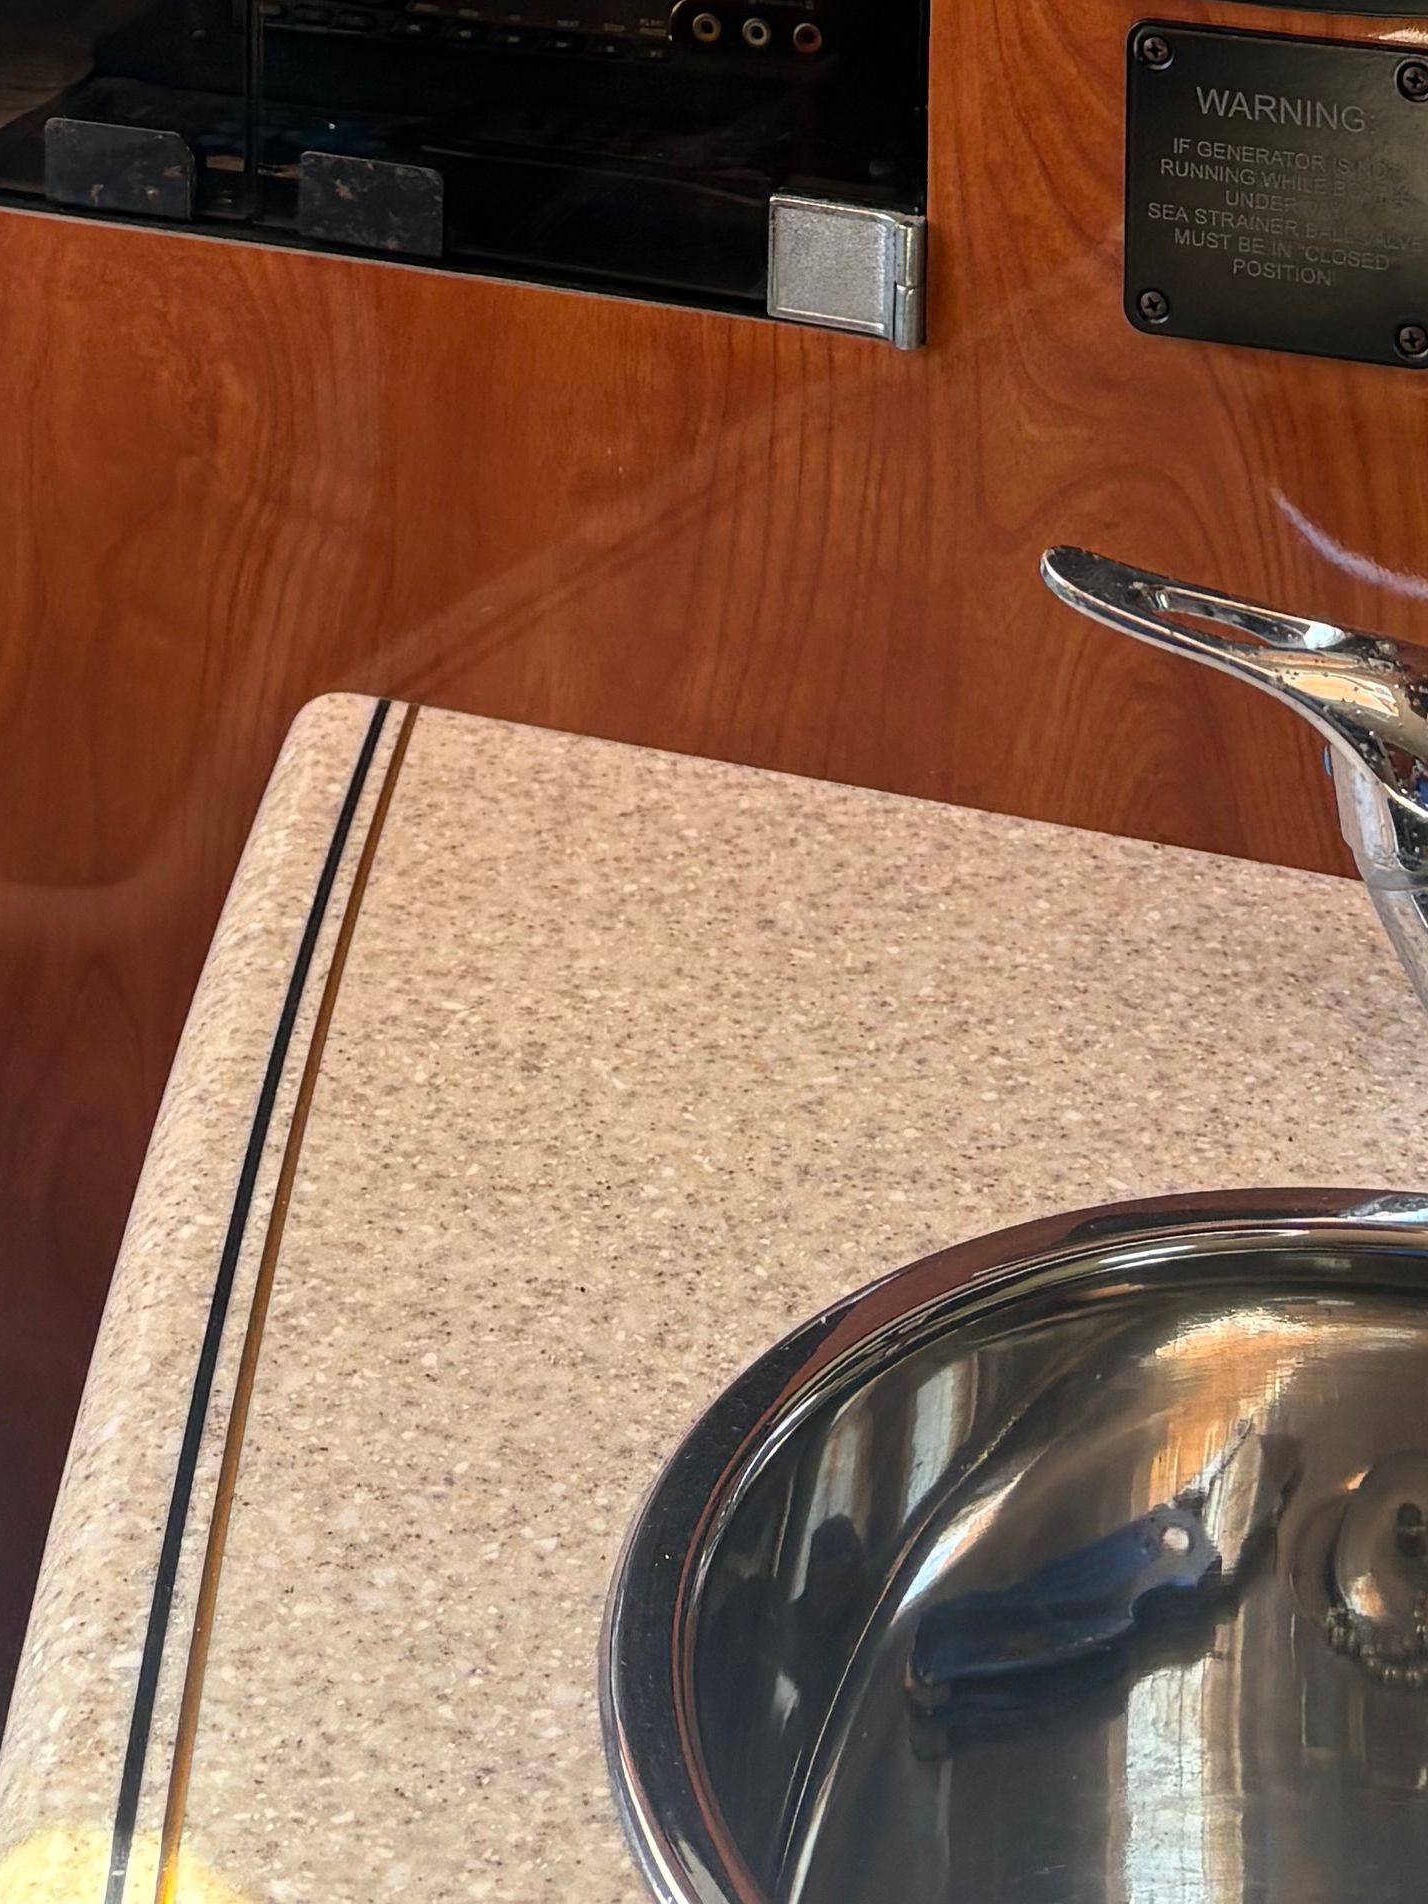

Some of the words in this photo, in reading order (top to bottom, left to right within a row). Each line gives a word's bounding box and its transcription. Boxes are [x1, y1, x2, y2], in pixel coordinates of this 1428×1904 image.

[1172, 137, 1192, 155] IF
[1196, 140, 1325, 171] GENERATOR
[1333, 158, 1350, 175] IS
[1160, 158, 1256, 185] RUNNING
[1261, 172, 1327, 195] WHILE
[1147, 202, 1189, 222] SEA
[1194, 208, 1300, 237] STRAINER
[1174, 227, 1232, 250] MUST
[1238, 236, 1265, 255] BE
[1272, 242, 1291, 258] IN
